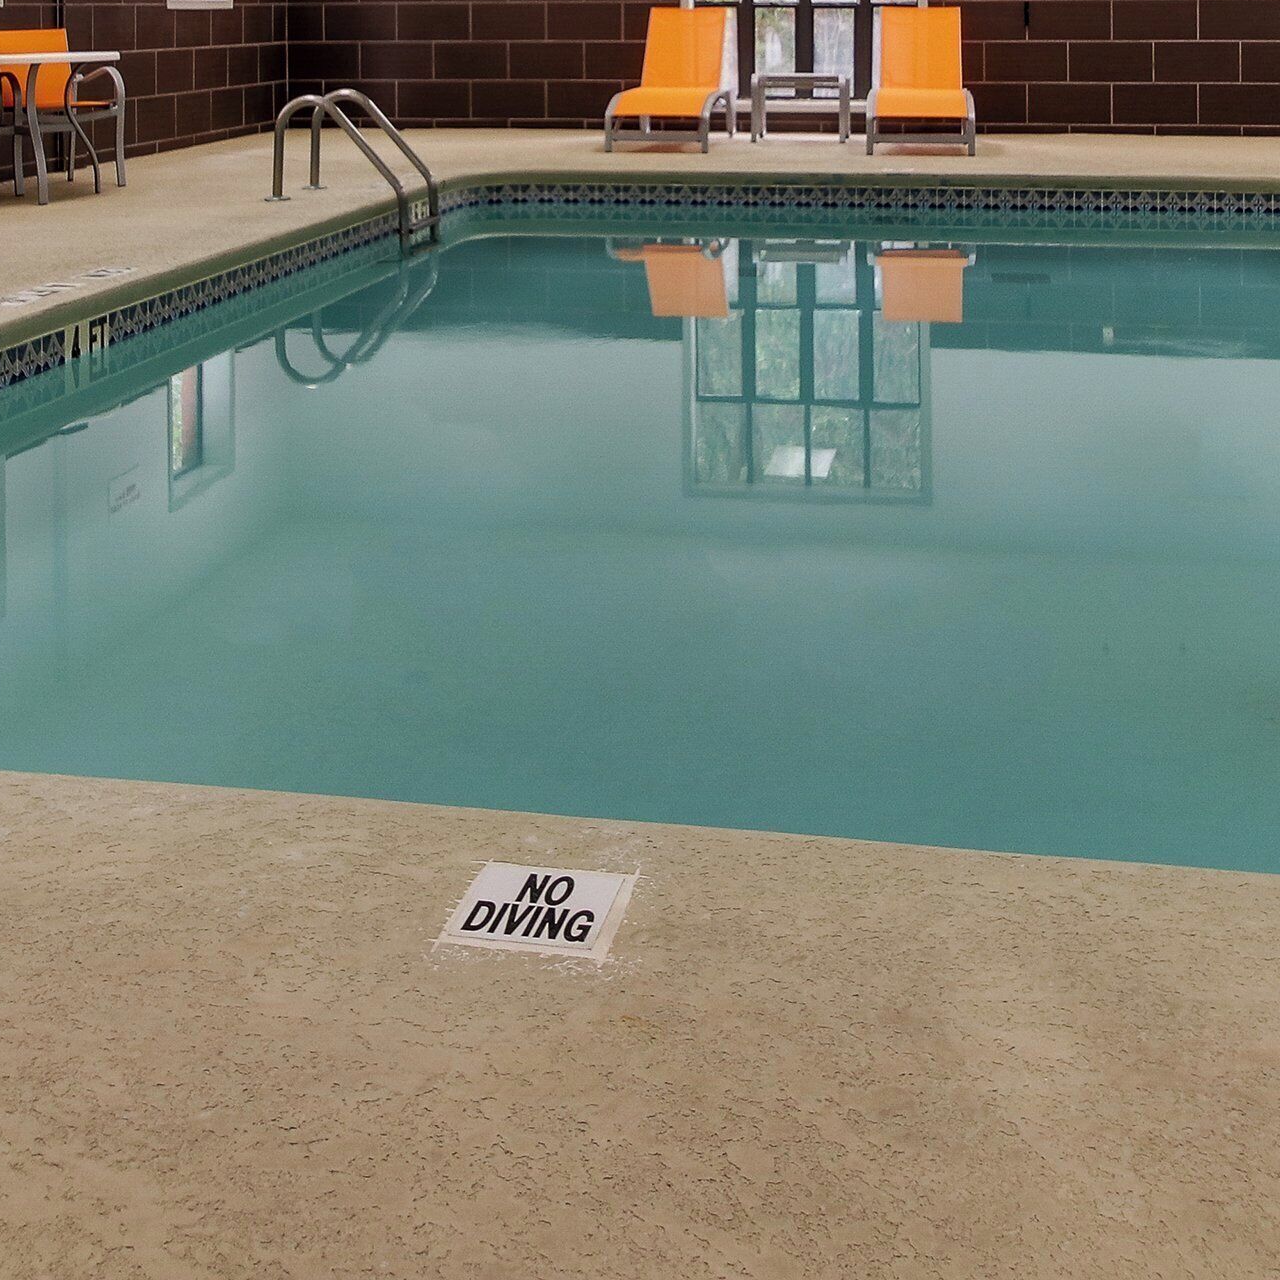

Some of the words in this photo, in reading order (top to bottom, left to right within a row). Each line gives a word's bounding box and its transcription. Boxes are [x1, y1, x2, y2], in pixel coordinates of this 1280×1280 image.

[89, 315, 108, 354] FT
[514, 873, 575, 907] NO
[460, 899, 595, 943] DIVING
